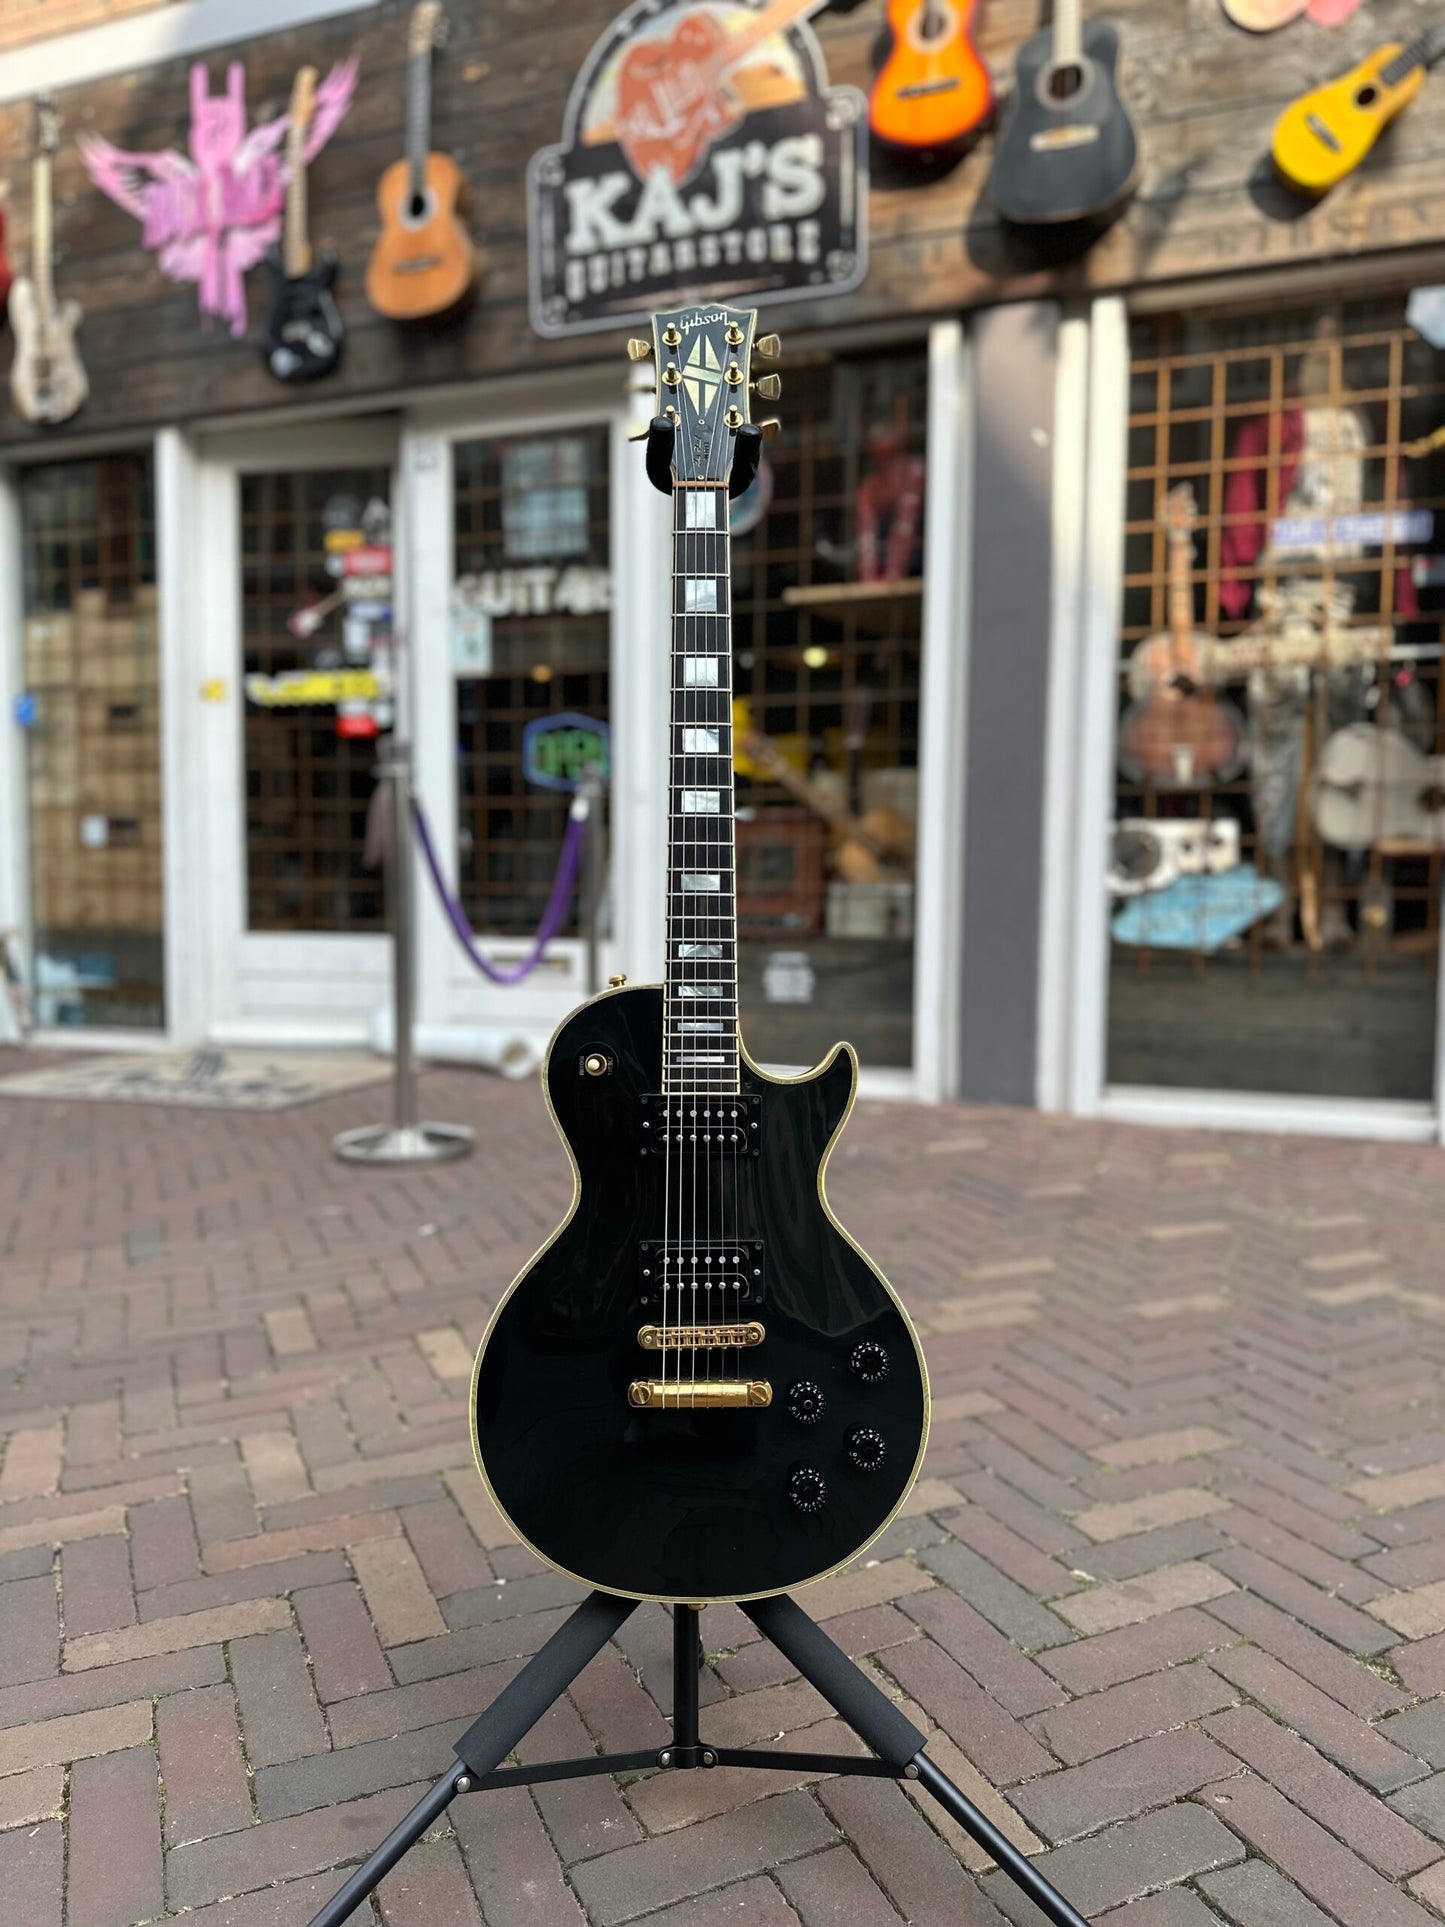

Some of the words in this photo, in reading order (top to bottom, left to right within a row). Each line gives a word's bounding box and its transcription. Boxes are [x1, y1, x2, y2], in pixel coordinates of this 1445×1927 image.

[565, 133, 826, 255] KAJ'S
[565, 219, 820, 302] GUITARSTORE
[680, 311, 731, 336] Gibson
